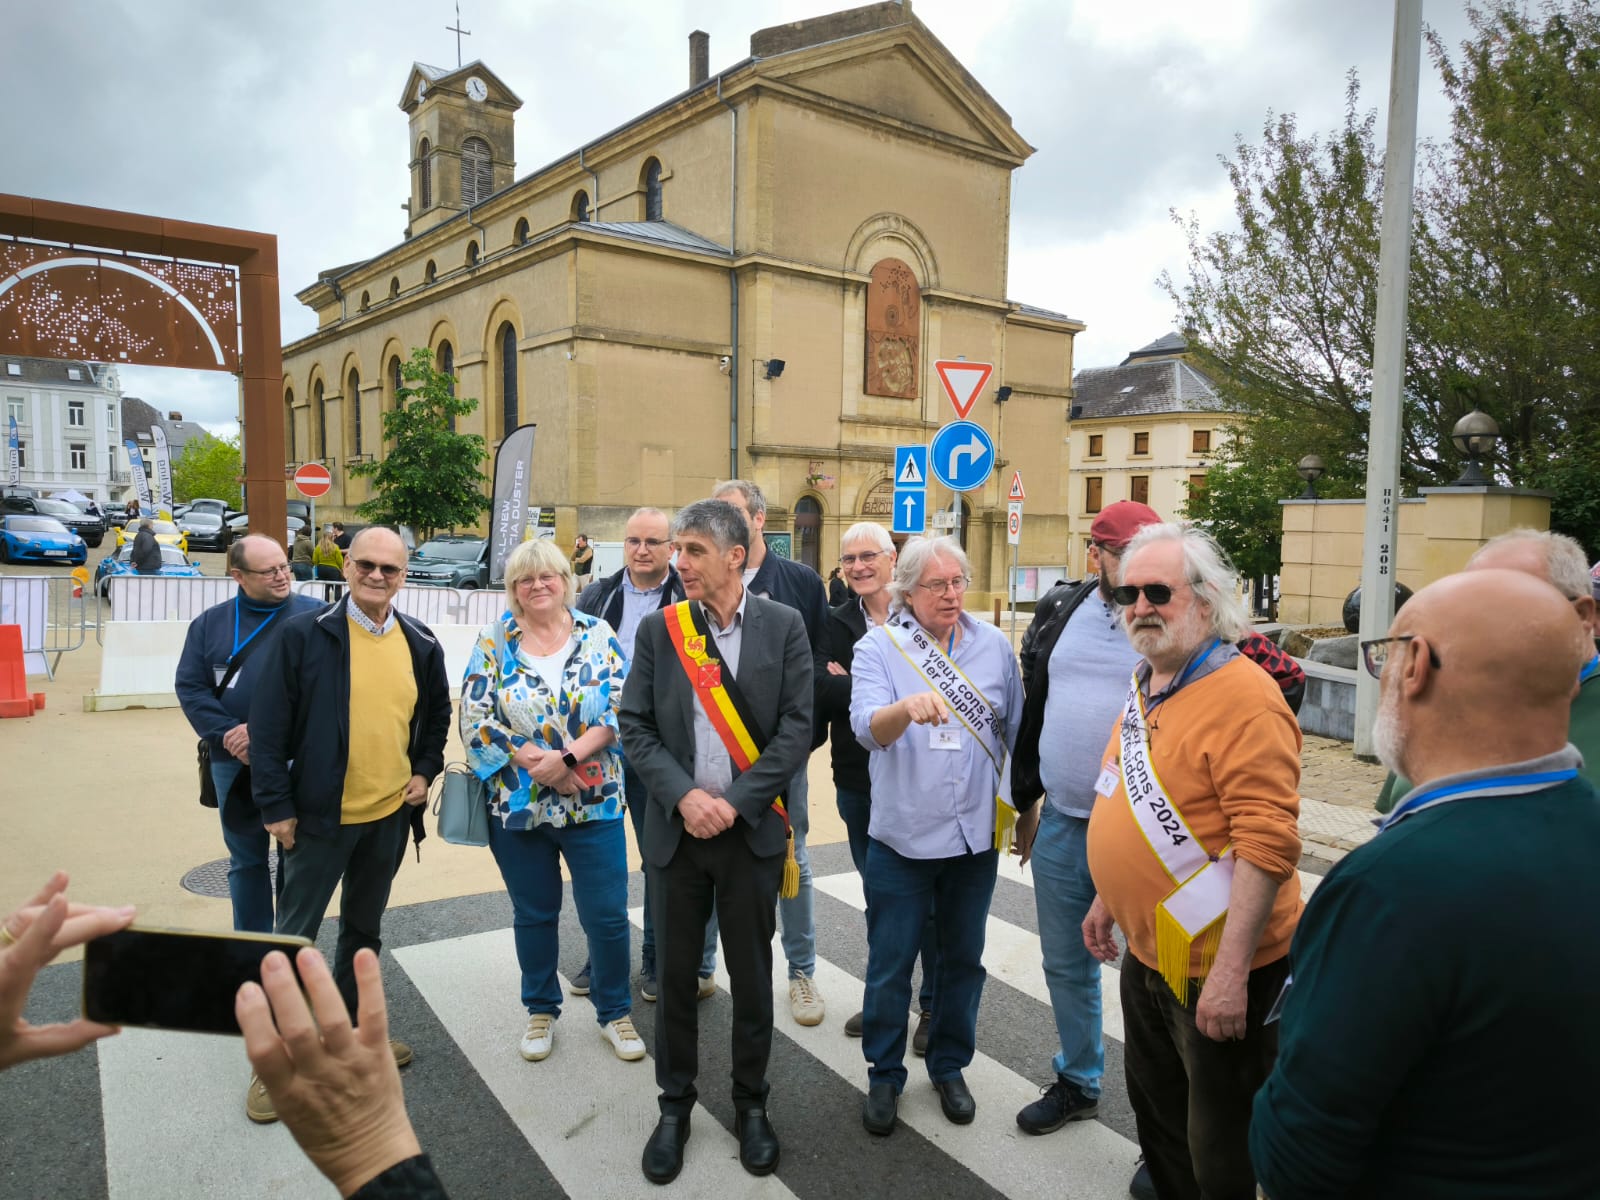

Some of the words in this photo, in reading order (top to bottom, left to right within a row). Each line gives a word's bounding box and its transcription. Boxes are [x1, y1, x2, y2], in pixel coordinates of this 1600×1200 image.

[512, 460, 525, 519] DUSTER
[1379, 544, 1389, 575] 208
[922, 659, 941, 680] 1er
[939, 681, 984, 731] dauphin
[928, 648, 959, 684] vieux
[958, 683, 986, 715] cons
[1134, 751, 1153, 795] cons
[1150, 797, 1189, 847] 2024
